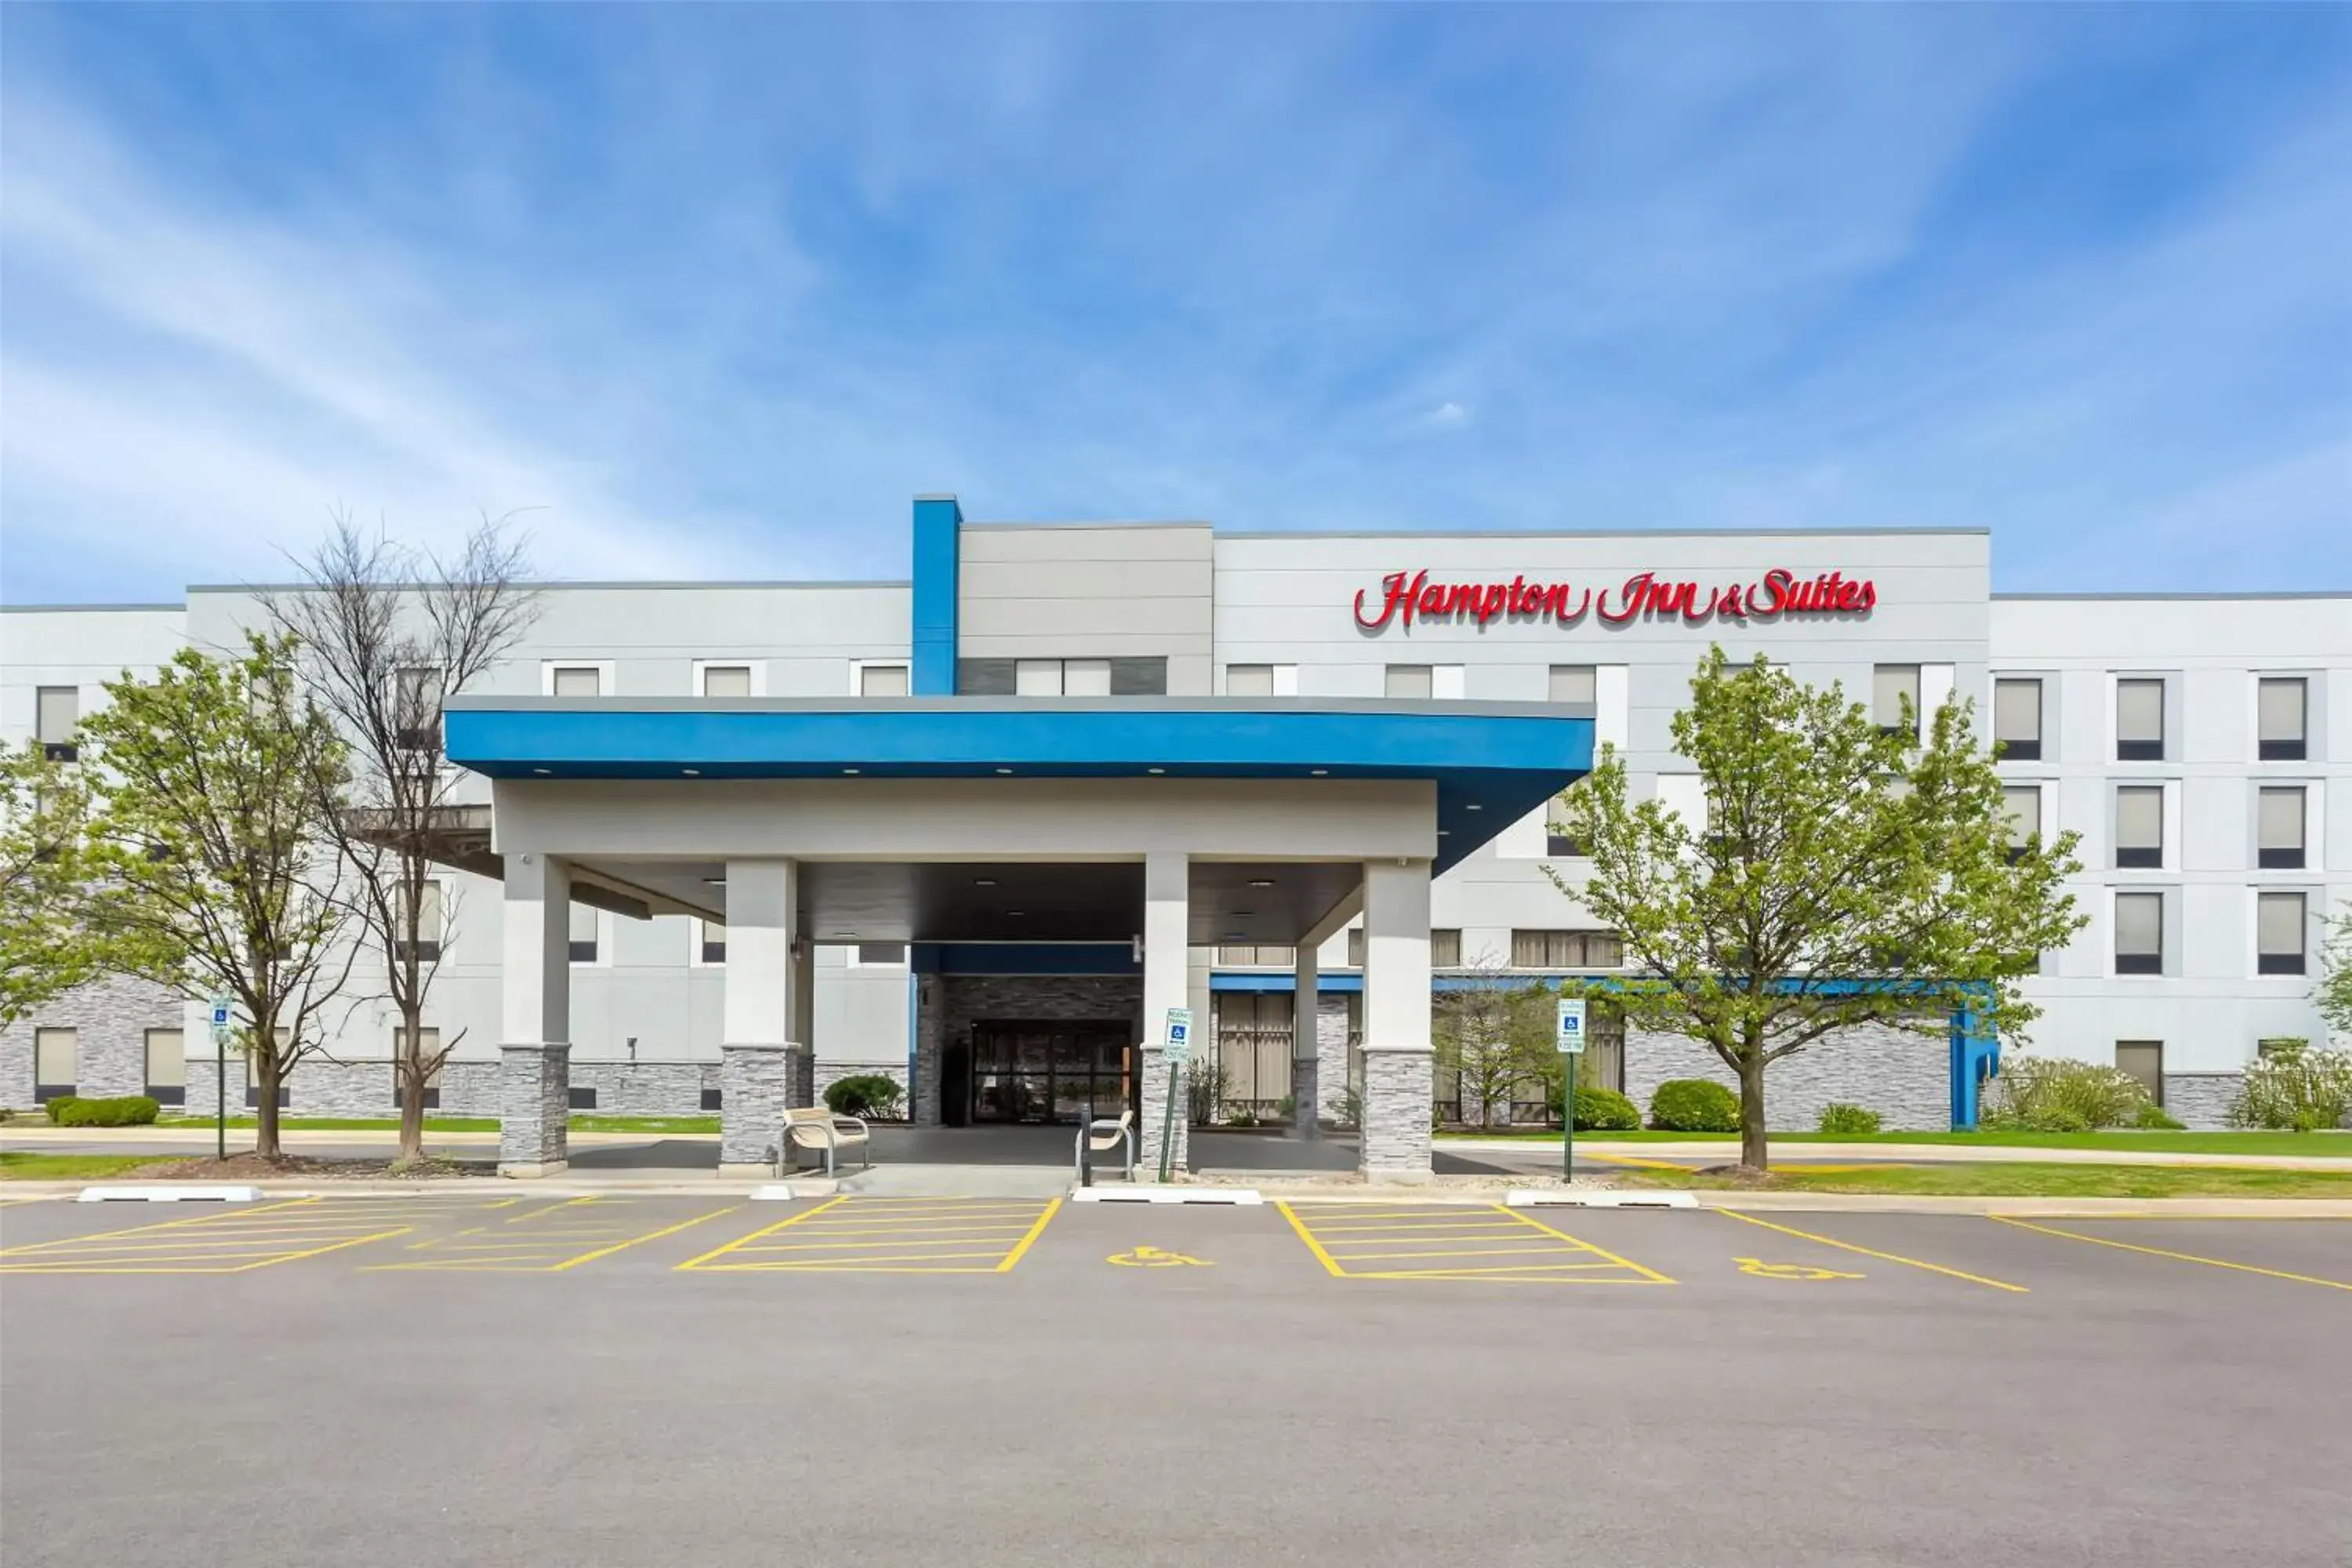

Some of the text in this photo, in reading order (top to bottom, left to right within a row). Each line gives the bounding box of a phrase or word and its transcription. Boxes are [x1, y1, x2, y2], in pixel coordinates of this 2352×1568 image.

[1354, 568, 1877, 627] Hampton Inn & Suites
